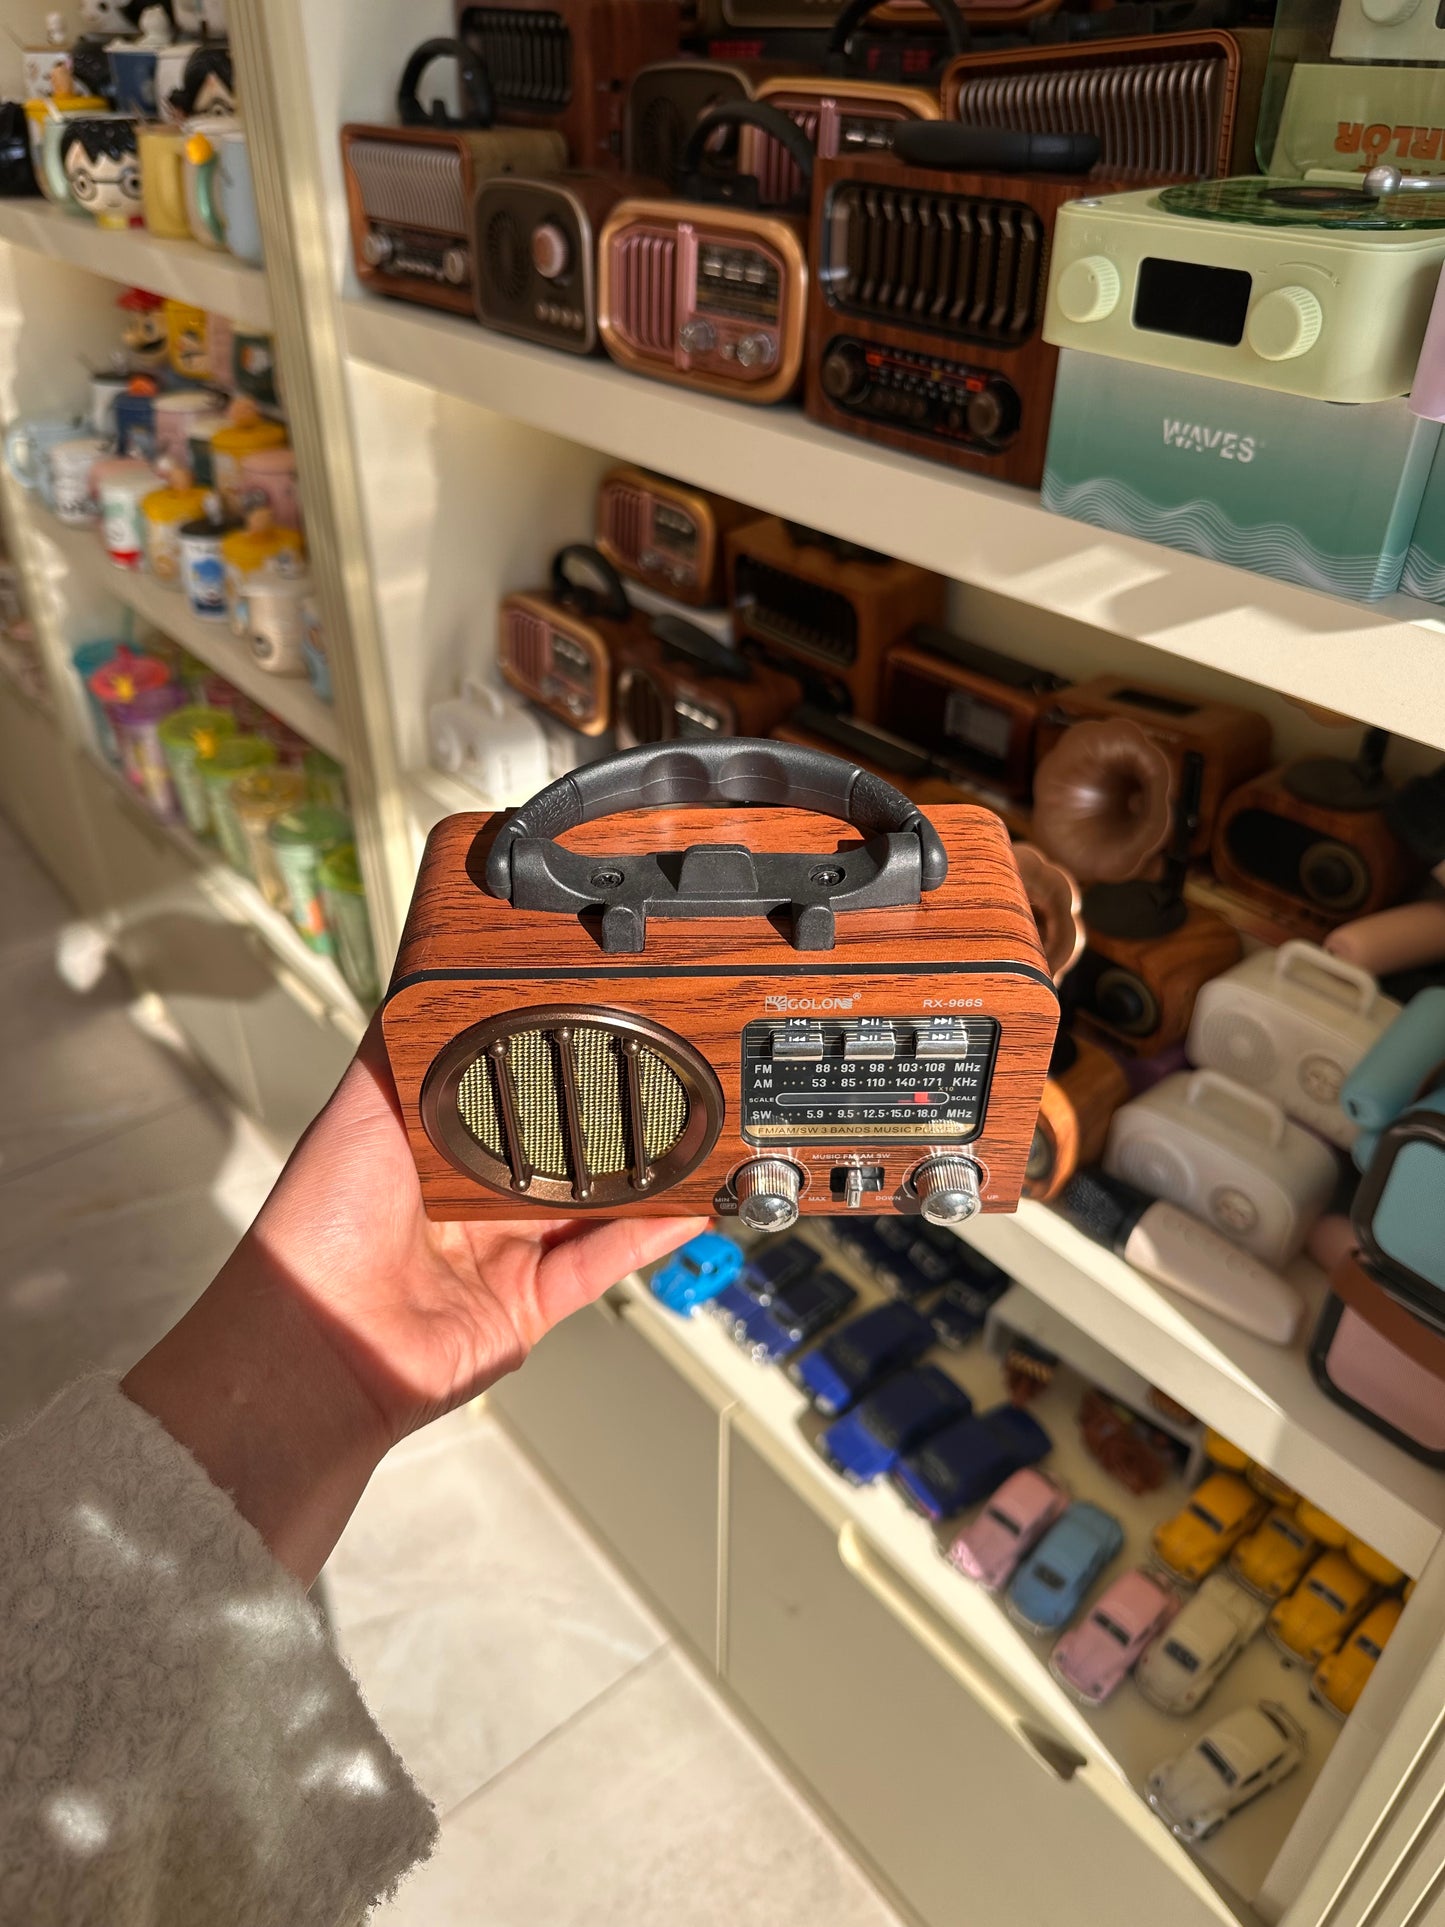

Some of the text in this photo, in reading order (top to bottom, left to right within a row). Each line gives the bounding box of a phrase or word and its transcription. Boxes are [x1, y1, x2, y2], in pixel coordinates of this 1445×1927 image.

[1163, 419, 1255, 463] WAVES
[923, 998, 983, 1008] RX-966S
[755, 1063, 981, 1073] FM 88 93 98 103 108 MHz
[754, 1078, 977, 1088] AM 53 85 110 140 171 KHz
[752, 1109, 972, 1119] SW 5.9 9.5 12.5 15.0 18.0 MHz
[758, 1126, 819, 1134] FM/AM/SW
